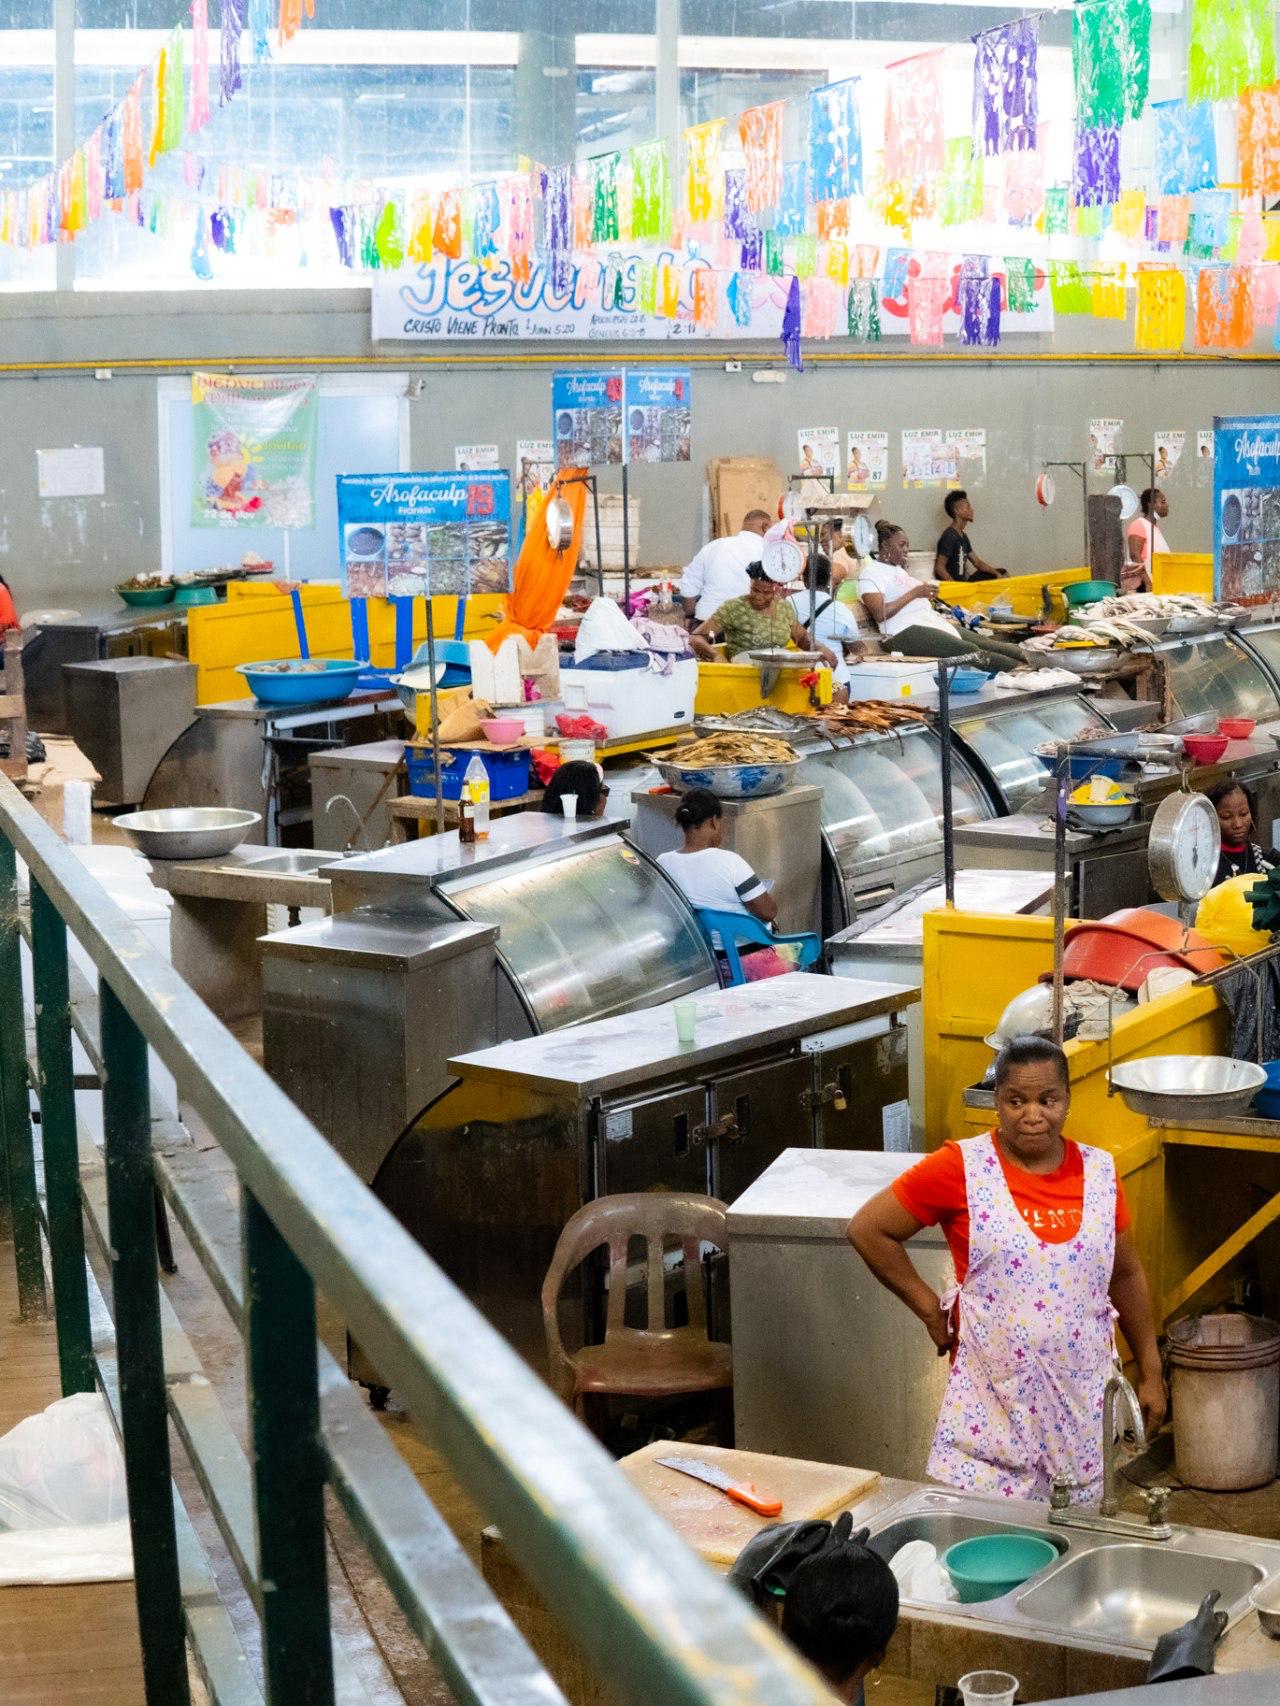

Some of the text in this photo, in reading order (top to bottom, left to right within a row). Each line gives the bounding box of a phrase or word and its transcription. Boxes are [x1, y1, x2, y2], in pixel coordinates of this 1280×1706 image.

[403, 318, 442, 335] CRISTO
[447, 316, 478, 335] VIENE
[904, 430, 919, 438] LUZ
[872, 471, 882, 480] 87
[370, 483, 468, 507] Asofaculp
[398, 506, 436, 515] Franklin
